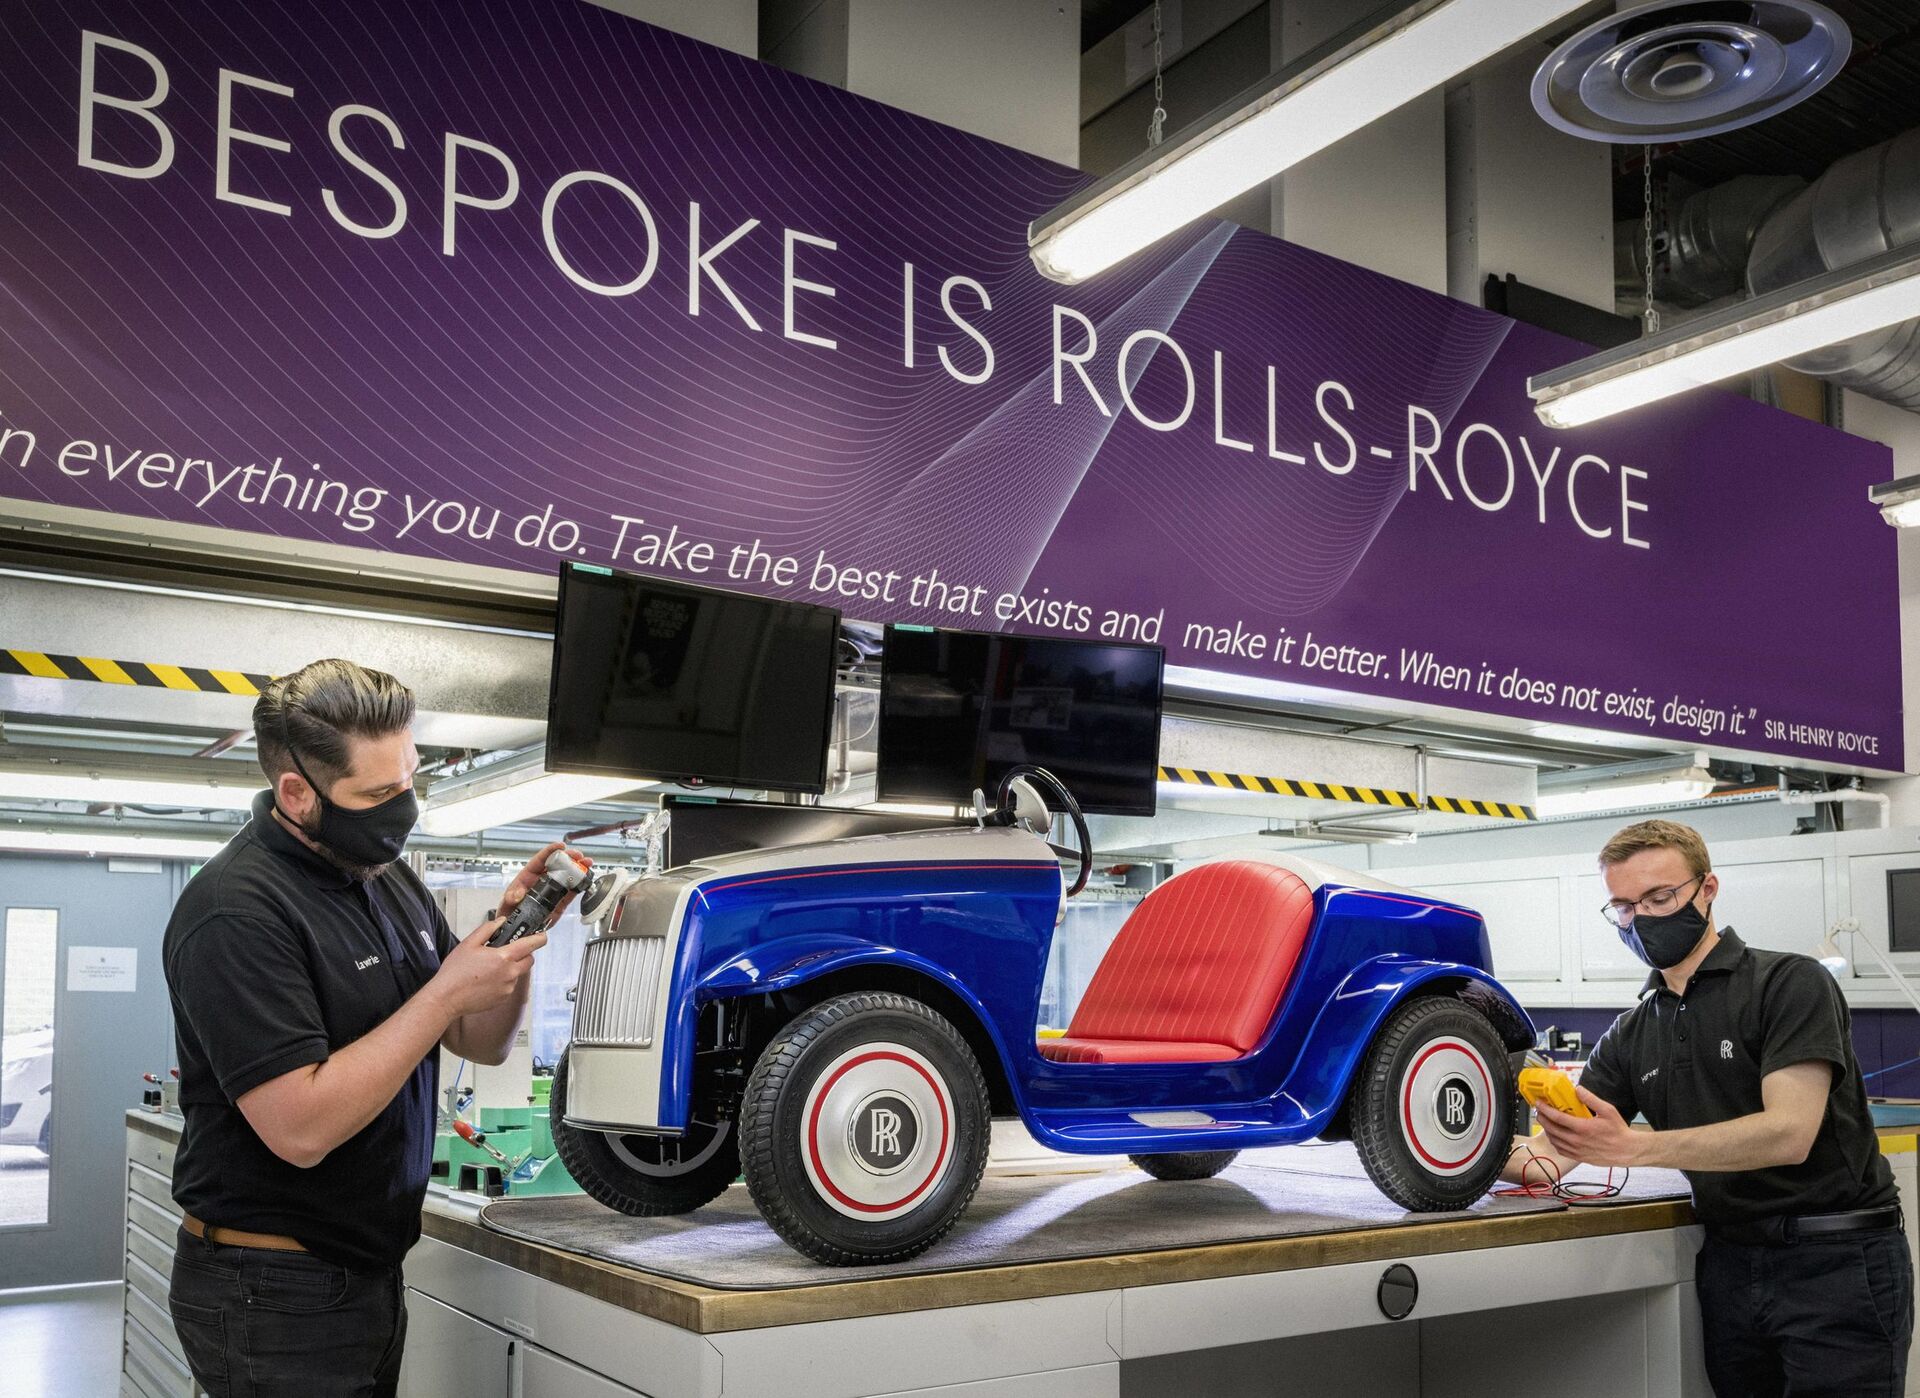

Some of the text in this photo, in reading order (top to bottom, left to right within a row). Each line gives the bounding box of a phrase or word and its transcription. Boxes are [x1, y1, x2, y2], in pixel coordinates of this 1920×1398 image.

[78, 29, 1650, 549] BESPOKE IS ROLLS-ROYCE
[0, 410, 36, 467] n
[57, 440, 388, 532] everything
[396, 495, 500, 540] you
[514, 504, 587, 555] do.
[610, 514, 714, 573] Take
[727, 538, 799, 586] the
[809, 550, 902, 603] best
[909, 574, 987, 616] that
[994, 587, 1093, 633] exists
[1099, 607, 1165, 644] and
[1182, 620, 1267, 660] make
[1273, 627, 1297, 664] it
[1300, 633, 1390, 681] better.
[1400, 648, 1471, 692] When
[1476, 661, 1496, 696] it
[1499, 667, 1556, 705] does
[1560, 685, 1602, 713] not
[1604, 688, 1657, 727] exist,
[1662, 696, 1726, 736] design
[1765, 719, 1787, 741] SIR
[1789, 724, 1834, 748] HENRY
[1838, 731, 1879, 755] ROYCE
[354, 955, 380, 970] Lawrie
[1445, 1087, 1466, 1125] RR
[870, 1108, 902, 1156] RR
